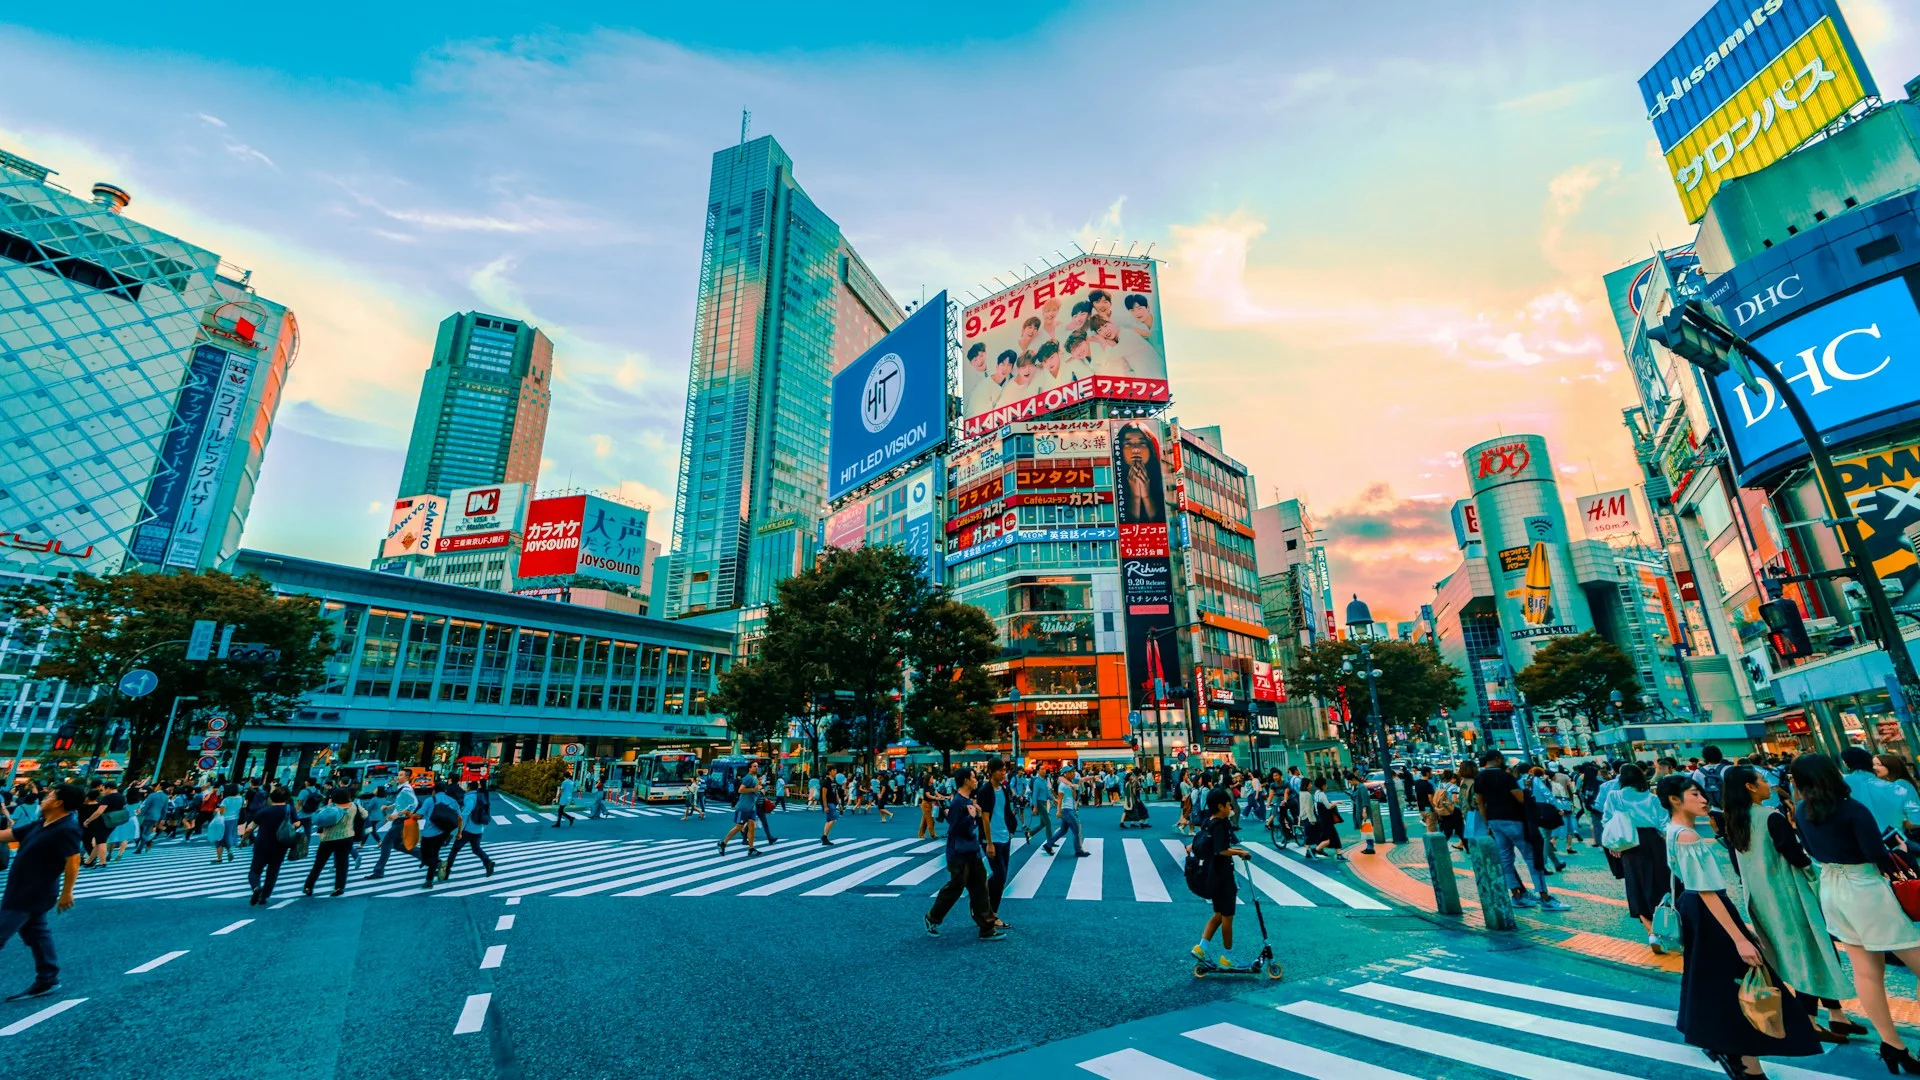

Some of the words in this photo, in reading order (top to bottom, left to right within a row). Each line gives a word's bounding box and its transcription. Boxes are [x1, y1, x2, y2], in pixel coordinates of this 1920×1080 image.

[1677, 56, 1836, 192] サロンパス
[965, 295, 1025, 338] 9.27
[1034, 267, 1152, 310] 日本上陸
[1734, 274, 1803, 326] DHC
[1733, 323, 1891, 428] DHC
[1096, 379, 1166, 397] ワナワン
[1026, 420, 1104, 431] しゃぶしゃぶバイキング
[1060, 435, 1106, 450] しゃぶ葉
[840, 462, 859, 485] HIT
[860, 449, 883, 474] LED
[884, 422, 927, 459] VISION
[1477, 449, 1530, 479] 109
[1018, 470, 1091, 484] コンタクト
[1069, 492, 1105, 506] ガスト
[1587, 495, 1626, 521] H&M
[387, 502, 426, 539] SANKYO
[983, 500, 1007, 520] ガスト
[420, 501, 439, 550] SANKYO
[527, 519, 580, 539] カラオケ
[586, 508, 644, 540] 大声
[973, 522, 1001, 545] ガスト
[1120, 524, 1167, 537] ユリゴコロ
[524, 536, 579, 552] JOYSOUND
[1049, 530, 1116, 540] 英会話イーオン
[579, 552, 641, 576] JOYSOUND
[1317, 549, 1325, 561] BIC
[1124, 561, 1168, 577] Rihwa
[1319, 561, 1330, 591] CAMERA
[1257, 715, 1279, 730] LUSH
